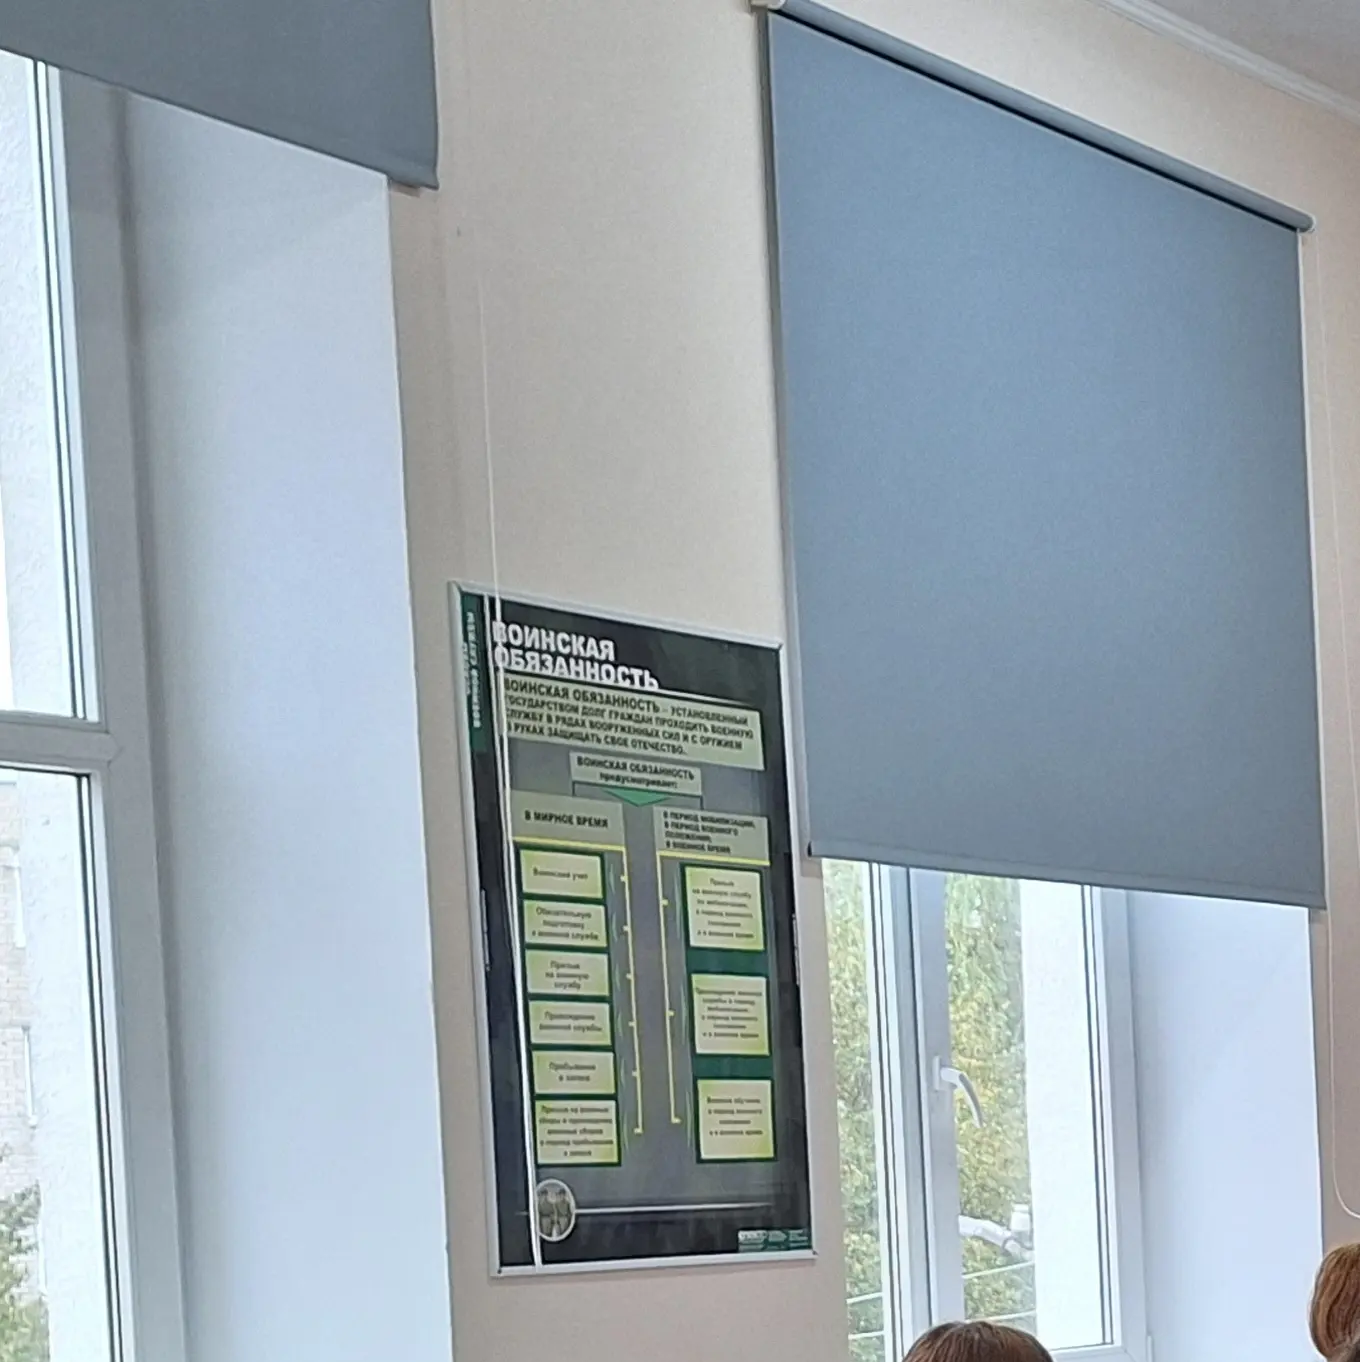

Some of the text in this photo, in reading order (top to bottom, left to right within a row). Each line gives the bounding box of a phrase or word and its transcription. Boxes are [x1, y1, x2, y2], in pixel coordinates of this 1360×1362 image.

[492, 620, 616, 661] ВОИНСКАЯ
[494, 644, 659, 690] ОБЯЗАННОСТЬ
[504, 678, 749, 726] ВОИНСКАЯ ОБЯЗАННОСТЬ УСТАНОВЛЕННЫЙ
[581, 704, 606, 719] ДОЛГ
[608, 708, 653, 724] ГРАЖДАН
[547, 727, 602, 744] ЗАЩИЩАТЬ
[576, 755, 695, 781] ВОИНСКАЯ ОБЯЗАННОСТЬ
